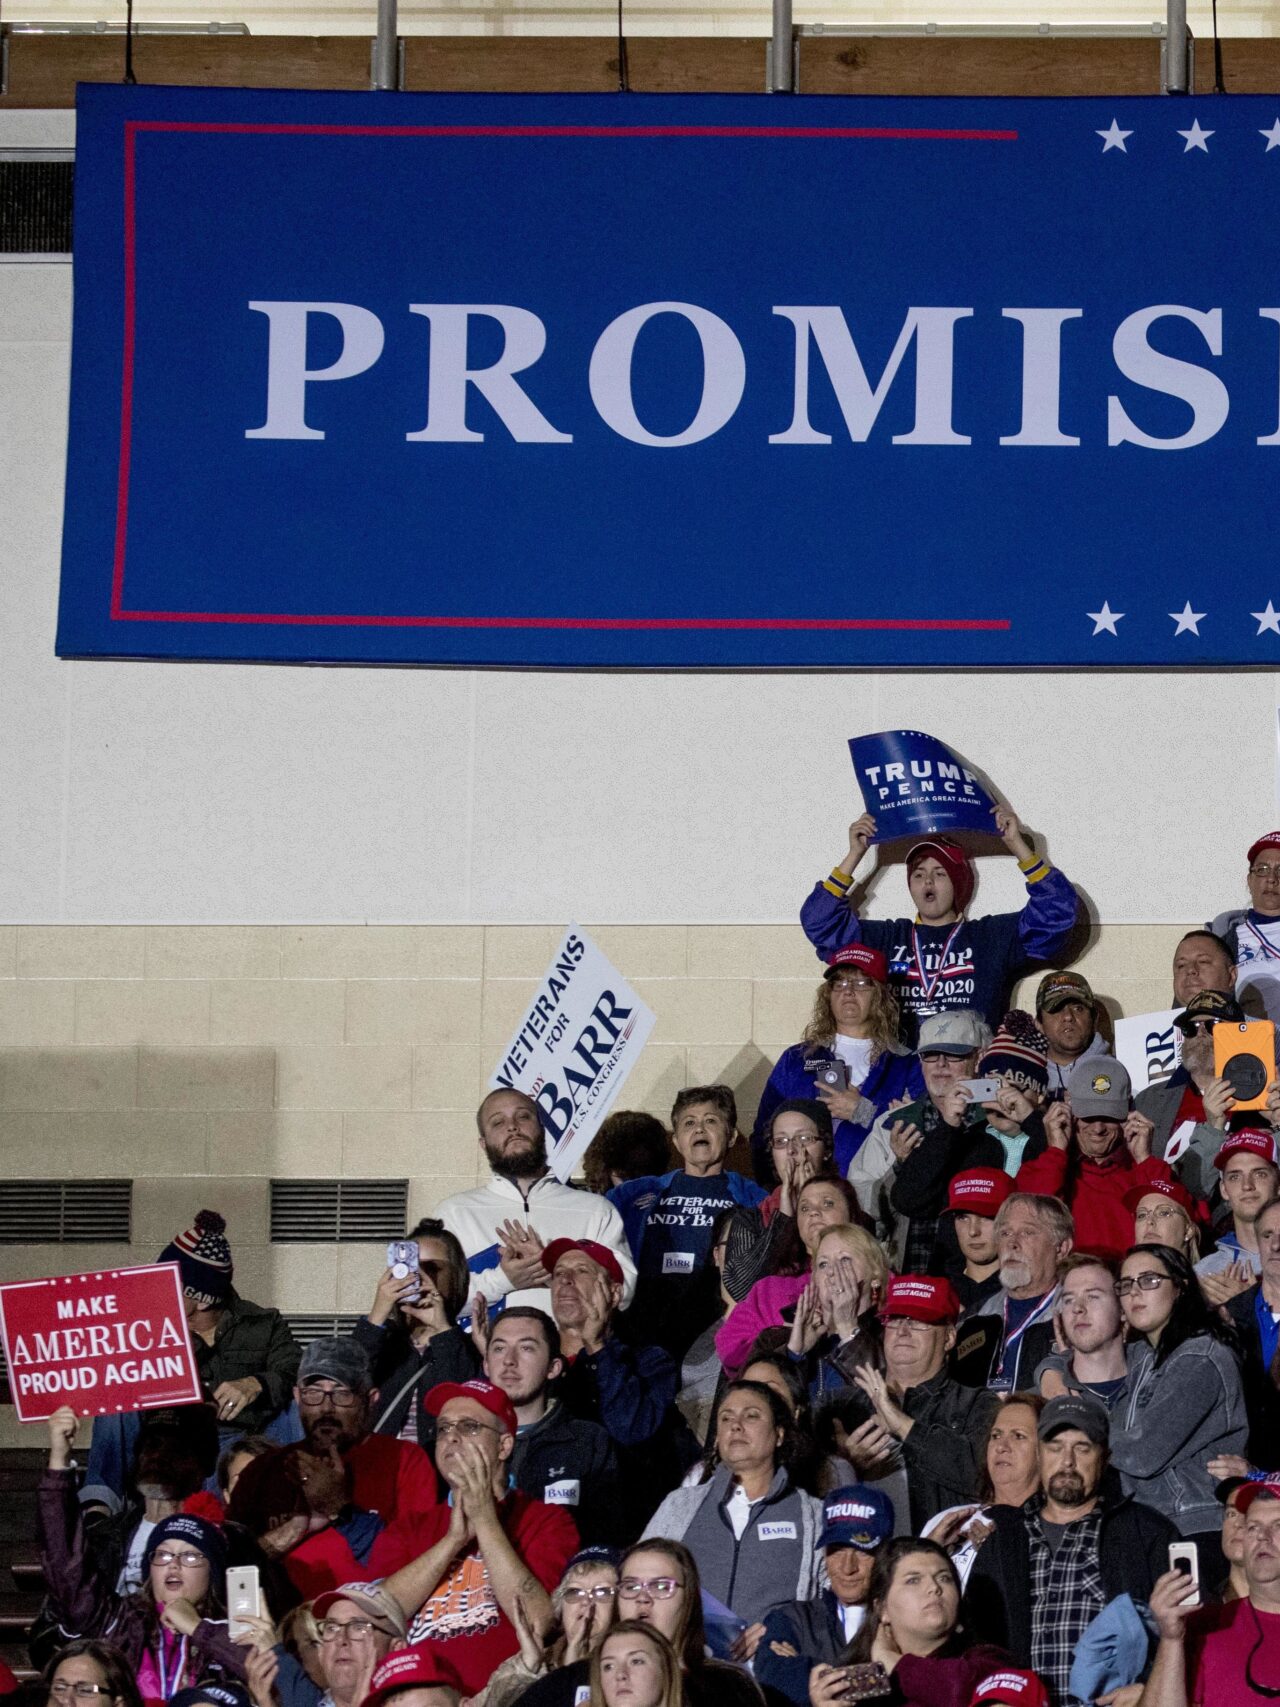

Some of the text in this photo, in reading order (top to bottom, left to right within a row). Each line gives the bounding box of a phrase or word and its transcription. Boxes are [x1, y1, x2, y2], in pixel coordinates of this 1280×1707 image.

[864, 760, 977, 786] TRUMP
[878, 780, 975, 799] PENCE
[879, 803, 896, 811] MAKE
[896, 796, 930, 807] AMERICA
[932, 795, 956, 803] GREAT
[848, 949, 875, 960] AMERICA
[853, 954, 871, 964] AGAIN
[934, 979, 975, 998] 2020
[496, 934, 584, 1088] VETERANS
[544, 1012, 570, 1053] FOR
[1146, 1026, 1175, 1084] RR
[533, 990, 633, 1150] BARR
[572, 1107, 589, 1131] U.S.
[586, 1038, 627, 1104] CONGRESS
[1240, 1132, 1269, 1143] AMERICA
[966, 1179, 995, 1188] AMERICA
[659, 1196, 735, 1209] VETERANS
[681, 1206, 704, 1215] FOR
[690, 1214, 715, 1227] BA
[183, 1285, 215, 1305] GAIN
[905, 1282, 936, 1293] AMERICA
[909, 1289, 932, 1299] AGAIN
[57, 1295, 118, 1319] MAKE
[12, 1317, 185, 1366] AMERICA
[19, 1355, 185, 1396] PROUD AGAIN
[826, 1503, 876, 1520] TRUMP
[761, 1526, 793, 1536] BARR
[994, 1672, 1029, 1687] AMERICA
[999, 1680, 1024, 1693] AGAIN
